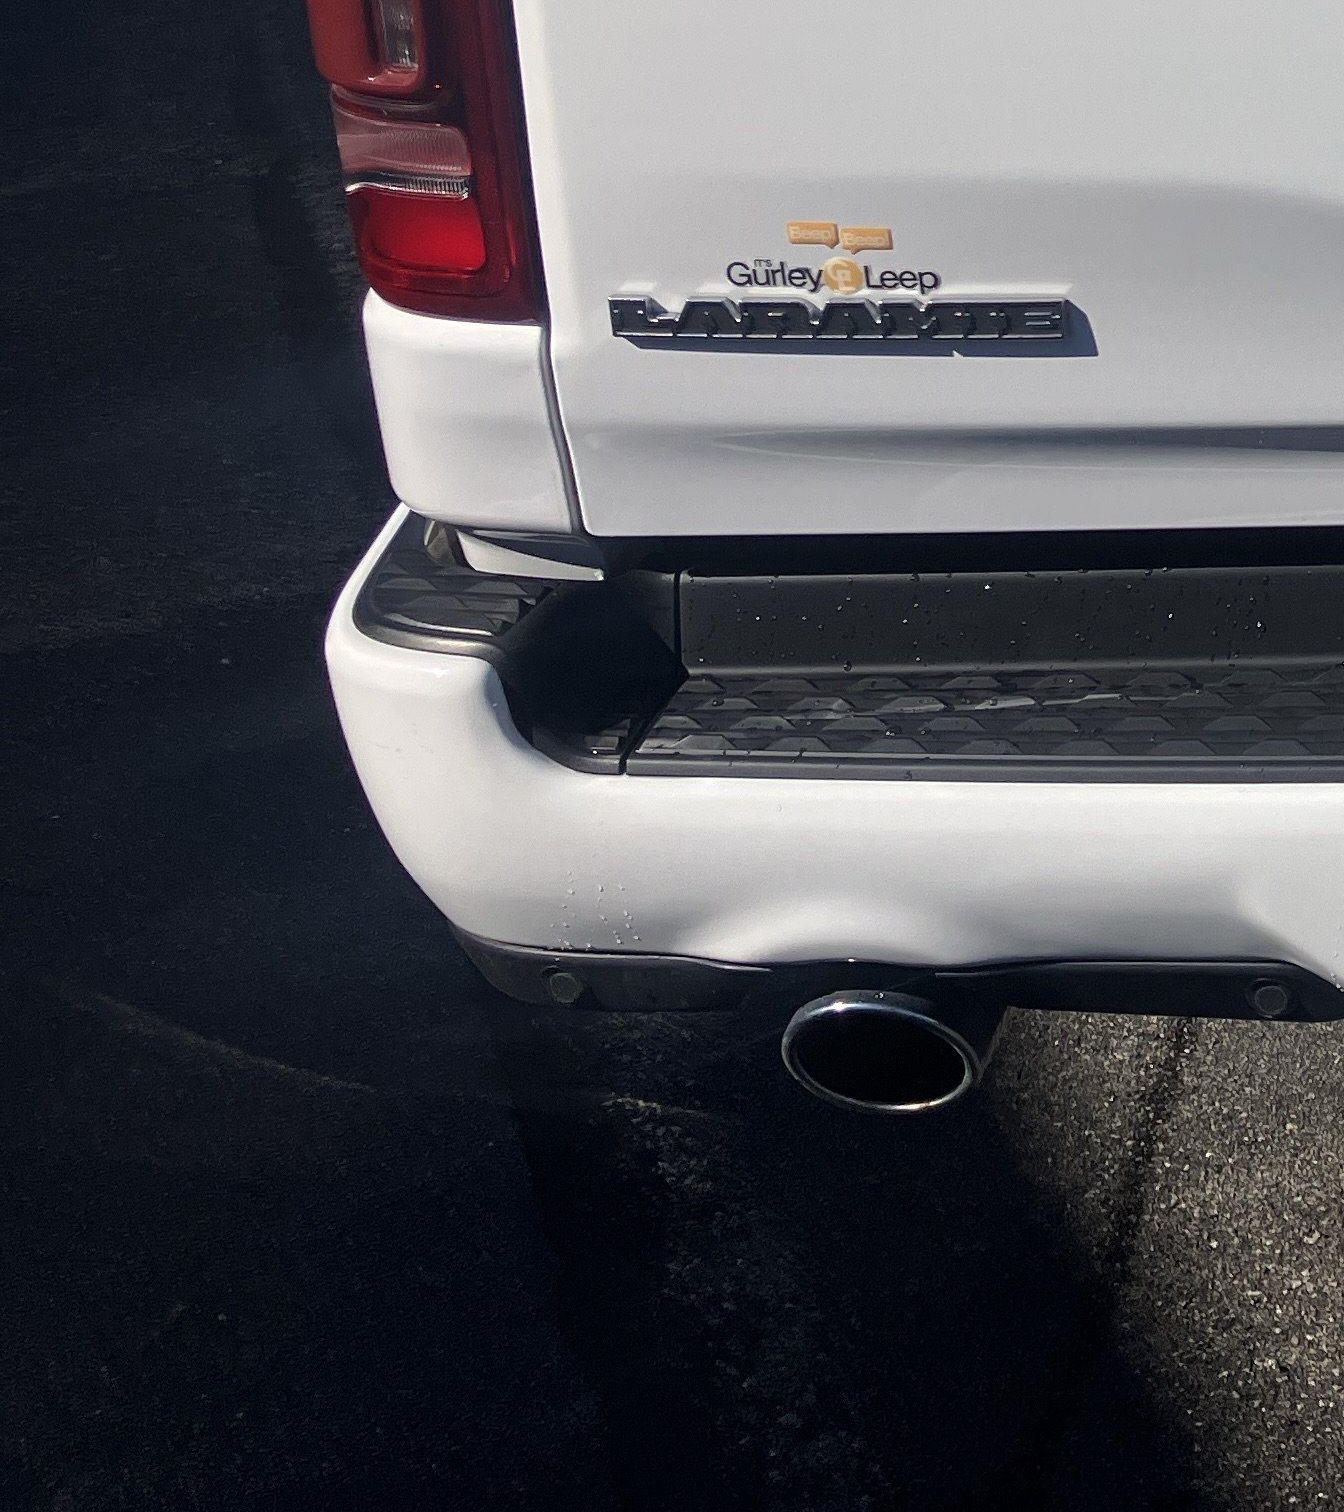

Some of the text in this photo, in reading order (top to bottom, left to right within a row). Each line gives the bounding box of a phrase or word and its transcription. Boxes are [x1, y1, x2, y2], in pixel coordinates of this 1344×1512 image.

[726, 260, 824, 293] Gurley
[863, 264, 941, 295] Leep
[608, 294, 1063, 339] LARAMIE
